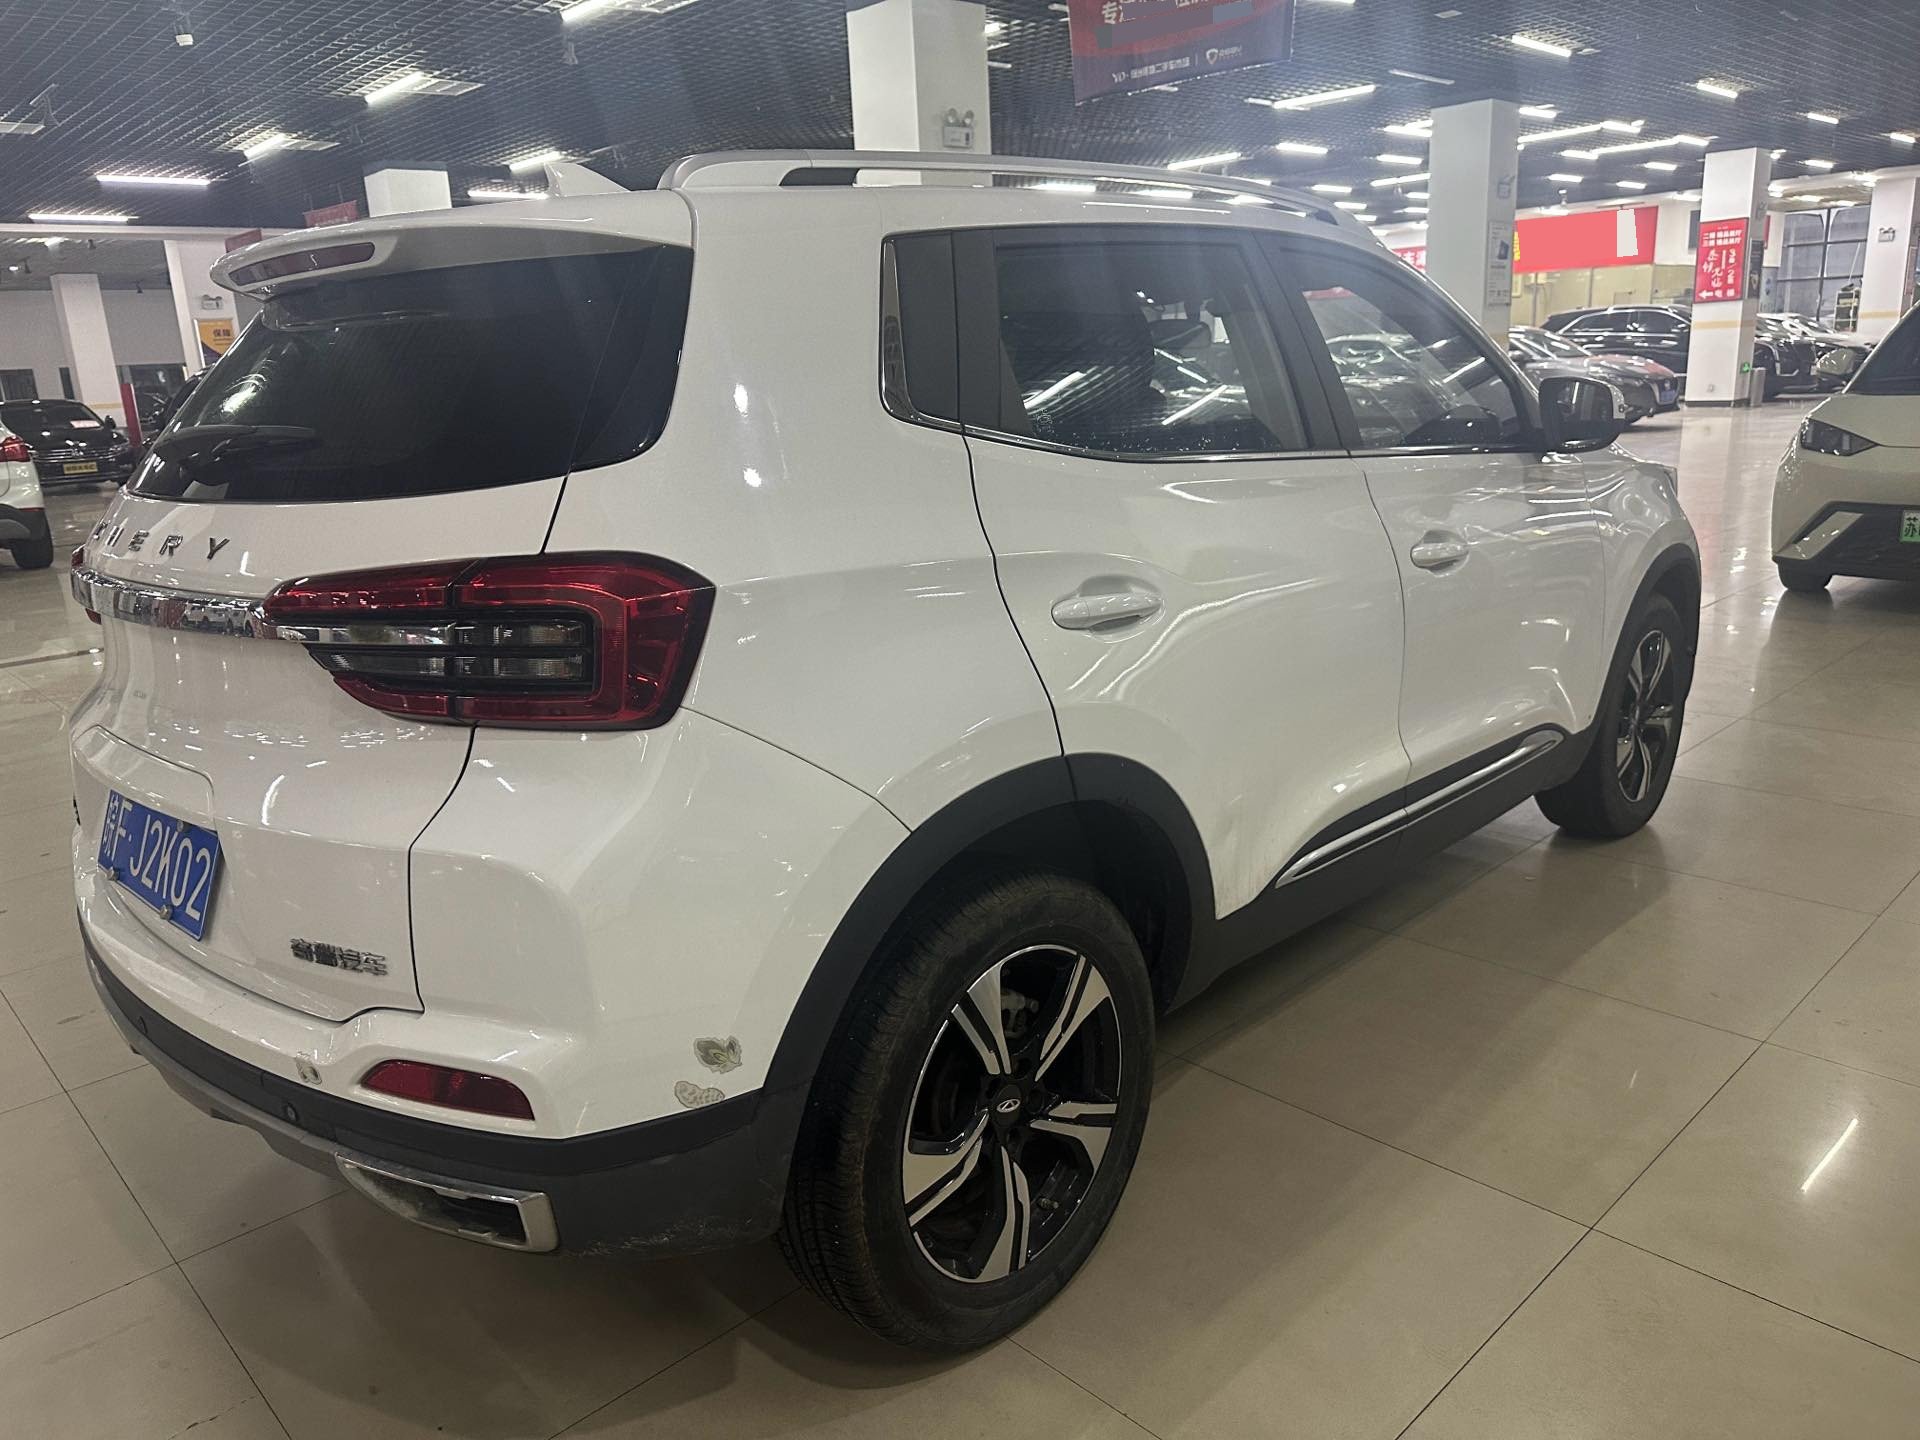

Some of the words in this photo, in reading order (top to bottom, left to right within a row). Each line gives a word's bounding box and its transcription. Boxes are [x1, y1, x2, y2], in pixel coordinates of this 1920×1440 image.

[1904, 516, 1920, 538] 苏
[290, 938, 388, 976] 奇瑞汽车
